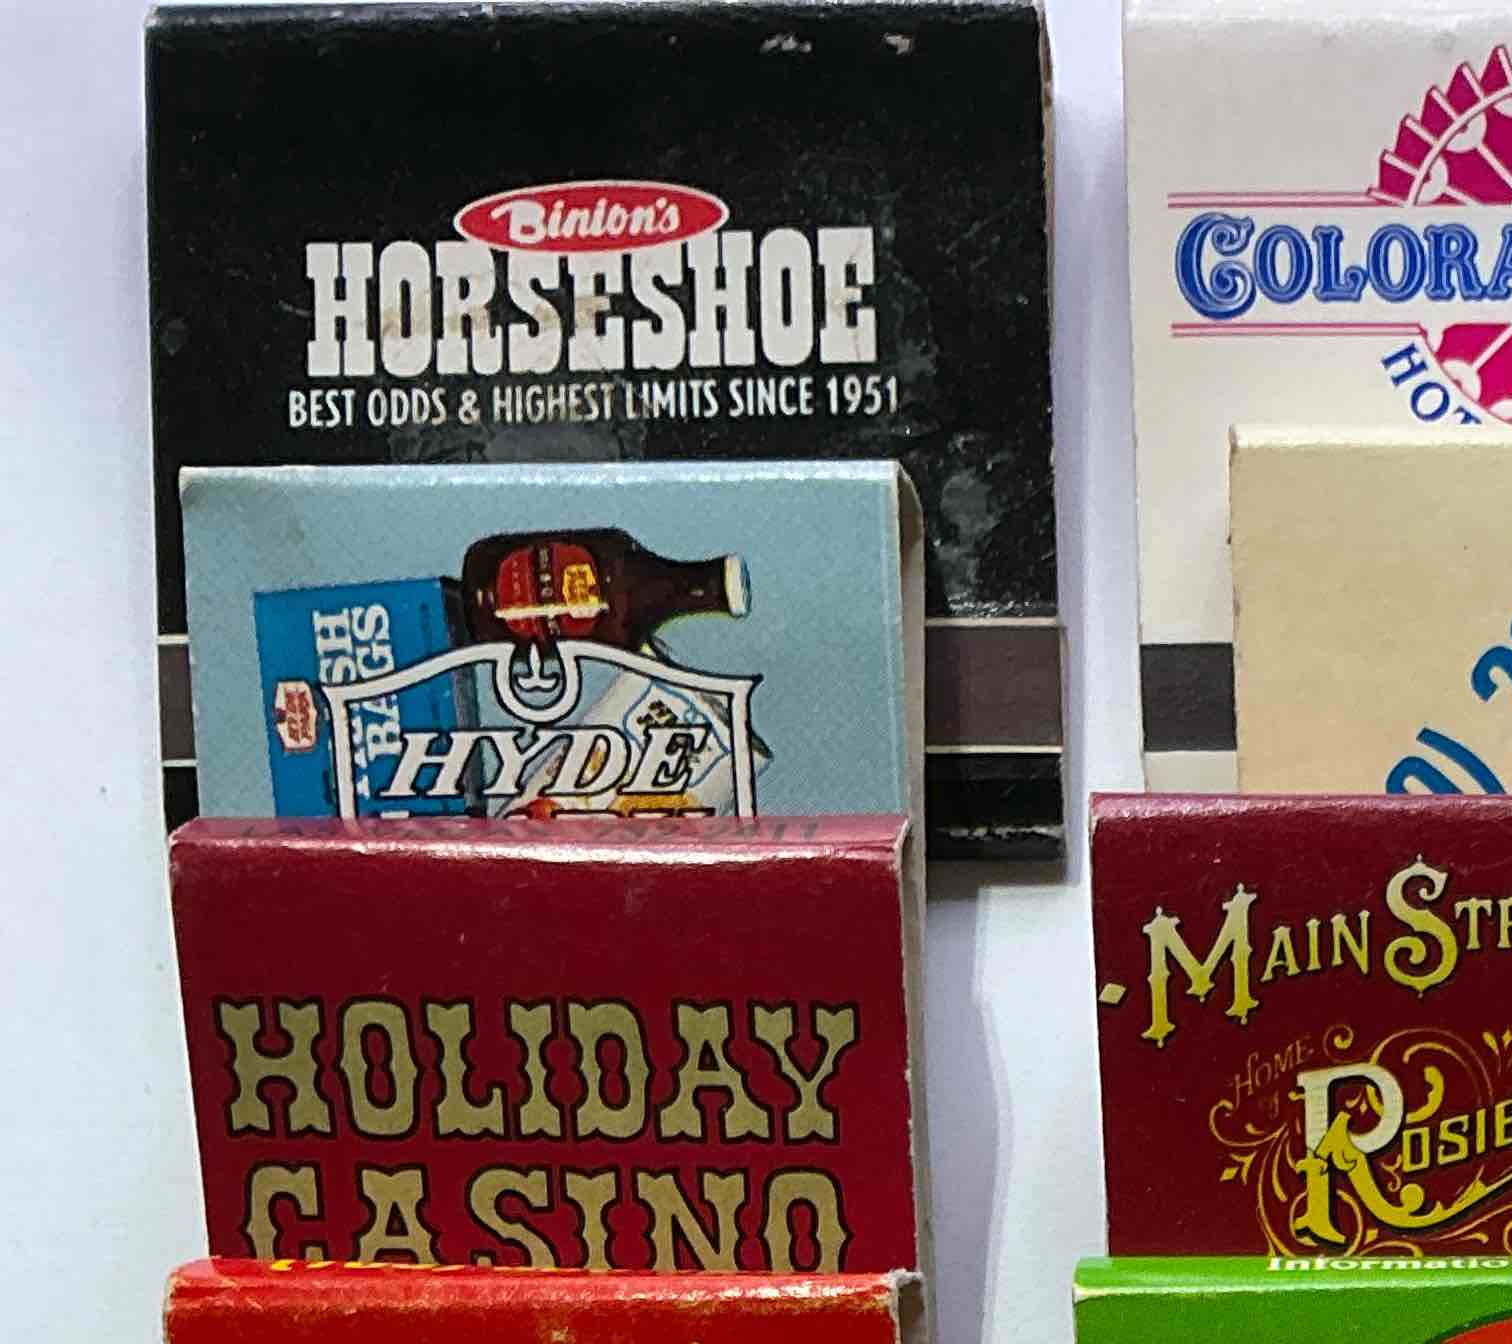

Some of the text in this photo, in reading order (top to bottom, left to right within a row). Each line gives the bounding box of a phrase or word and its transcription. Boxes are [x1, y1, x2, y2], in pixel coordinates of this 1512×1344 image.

[494, 191, 682, 242] Binion's
[305, 228, 878, 379] HORSESHOE
[288, 375, 901, 429] BEST ODDS & HIGHEST LIMITS SINCE 1951
[380, 724, 713, 799] HYDE
[1142, 882, 1371, 1048] MAIN
[212, 997, 862, 1145] HOLIDAY
[240, 1162, 854, 1273] CASINO
